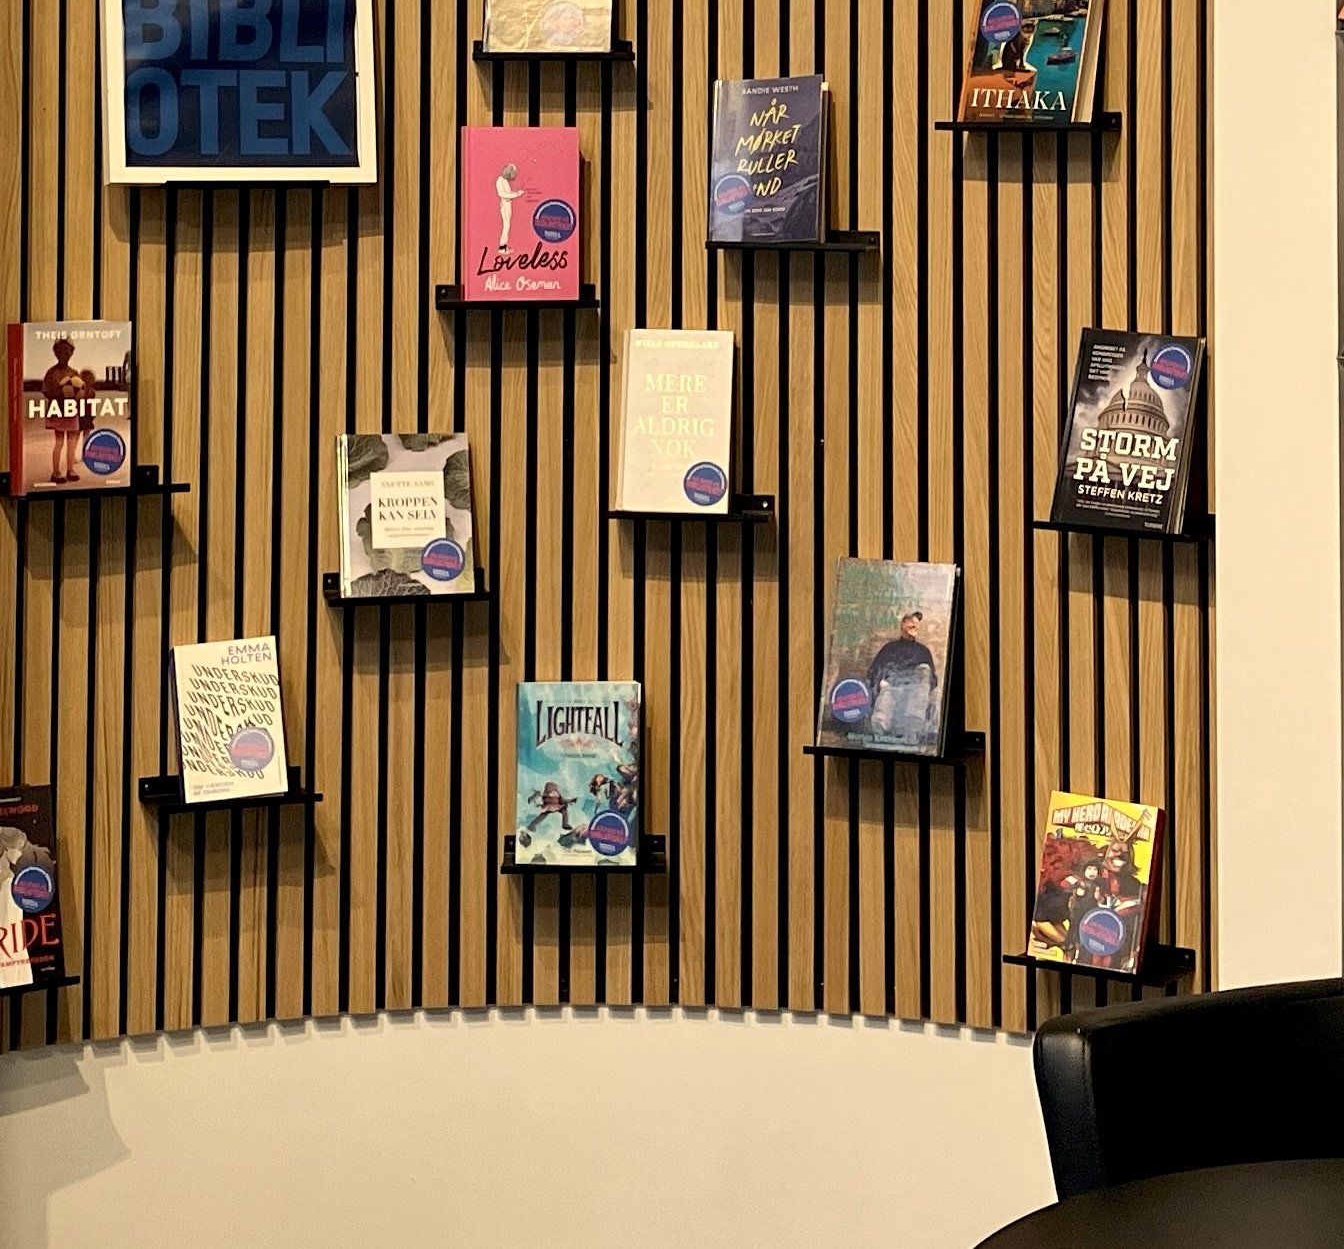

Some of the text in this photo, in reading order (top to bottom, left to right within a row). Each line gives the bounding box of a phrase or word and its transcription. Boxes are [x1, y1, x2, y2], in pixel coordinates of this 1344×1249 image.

[971, 88, 1066, 111] ITHAKA
[127, 67, 351, 156] OTEK
[750, 98, 790, 126] NÅR
[735, 124, 801, 156] MØRKET
[737, 149, 799, 176] RULLER
[477, 242, 568, 275] Loveless
[484, 274, 561, 292] Alice Oseman
[645, 373, 707, 392] MERE
[28, 398, 128, 418] HABITAT
[661, 395, 688, 414] ER
[633, 417, 715, 436] ALDRIG
[1081, 428, 1179, 461] STORM
[1073, 453, 1175, 491] PÅ VEJ
[378, 496, 438, 508] KROPPEN
[1078, 484, 1163, 505] STEFFEN KRETZ
[379, 509, 438, 521] KAN SELV
[221, 652, 272, 666] HOLTEN
[227, 642, 271, 656] EMMA
[191, 664, 279, 686] UNDERSKUD
[189, 677, 277, 700] UNDERSKUD
[536, 700, 624, 748] LIGHTFALL
